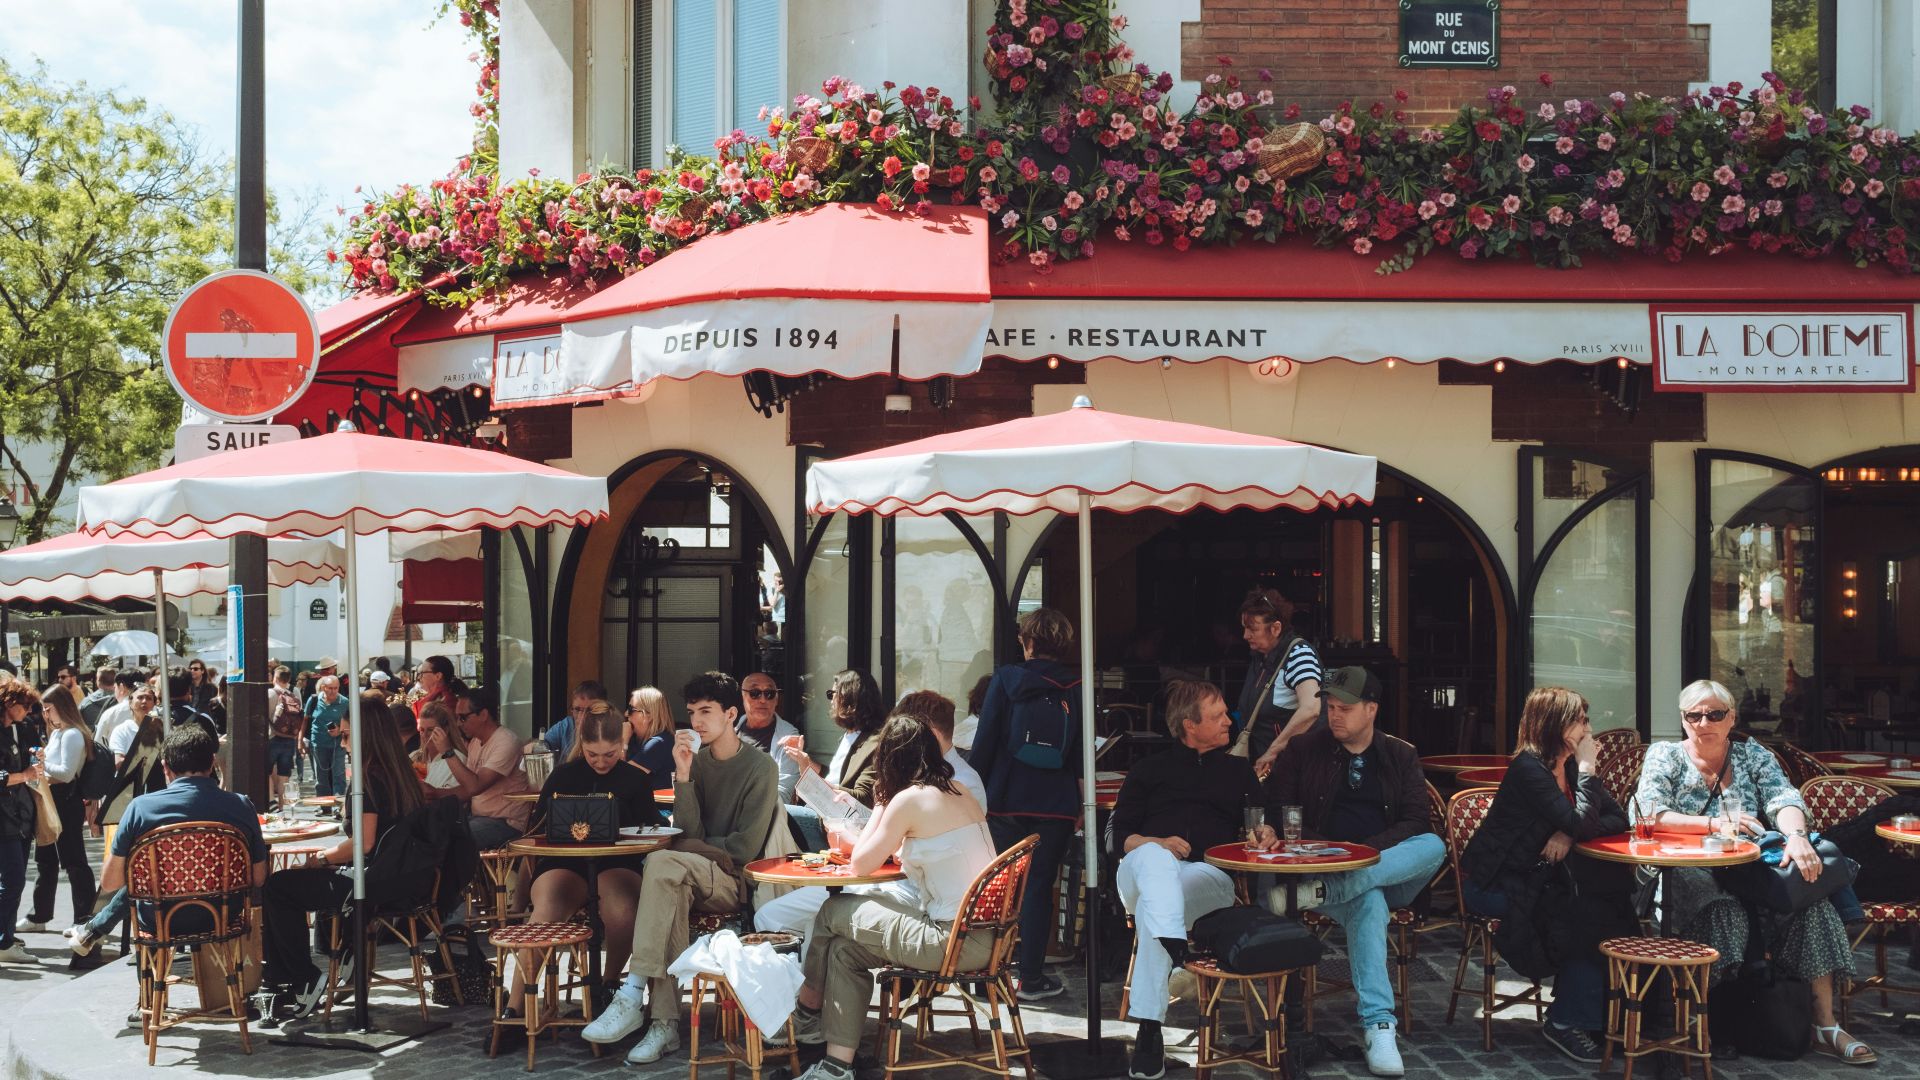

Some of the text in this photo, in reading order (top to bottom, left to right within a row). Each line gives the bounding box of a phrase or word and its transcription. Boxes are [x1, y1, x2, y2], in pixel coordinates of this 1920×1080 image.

[1436, 12, 1463, 27] RUE
[1443, 29, 1455, 38] DU
[1408, 40, 1490, 55] MONT CENIS
[663, 327, 838, 354] DEPUIS 1894
[985, 328, 1268, 348] AFE RESTAURANT
[1675, 323, 1893, 358] LA BOHEME
[1562, 343, 1645, 355] PARIS XVIII
[504, 350, 529, 379] LA
[443, 373, 465, 383] PARIS
[207, 431, 271, 451] SAUF
